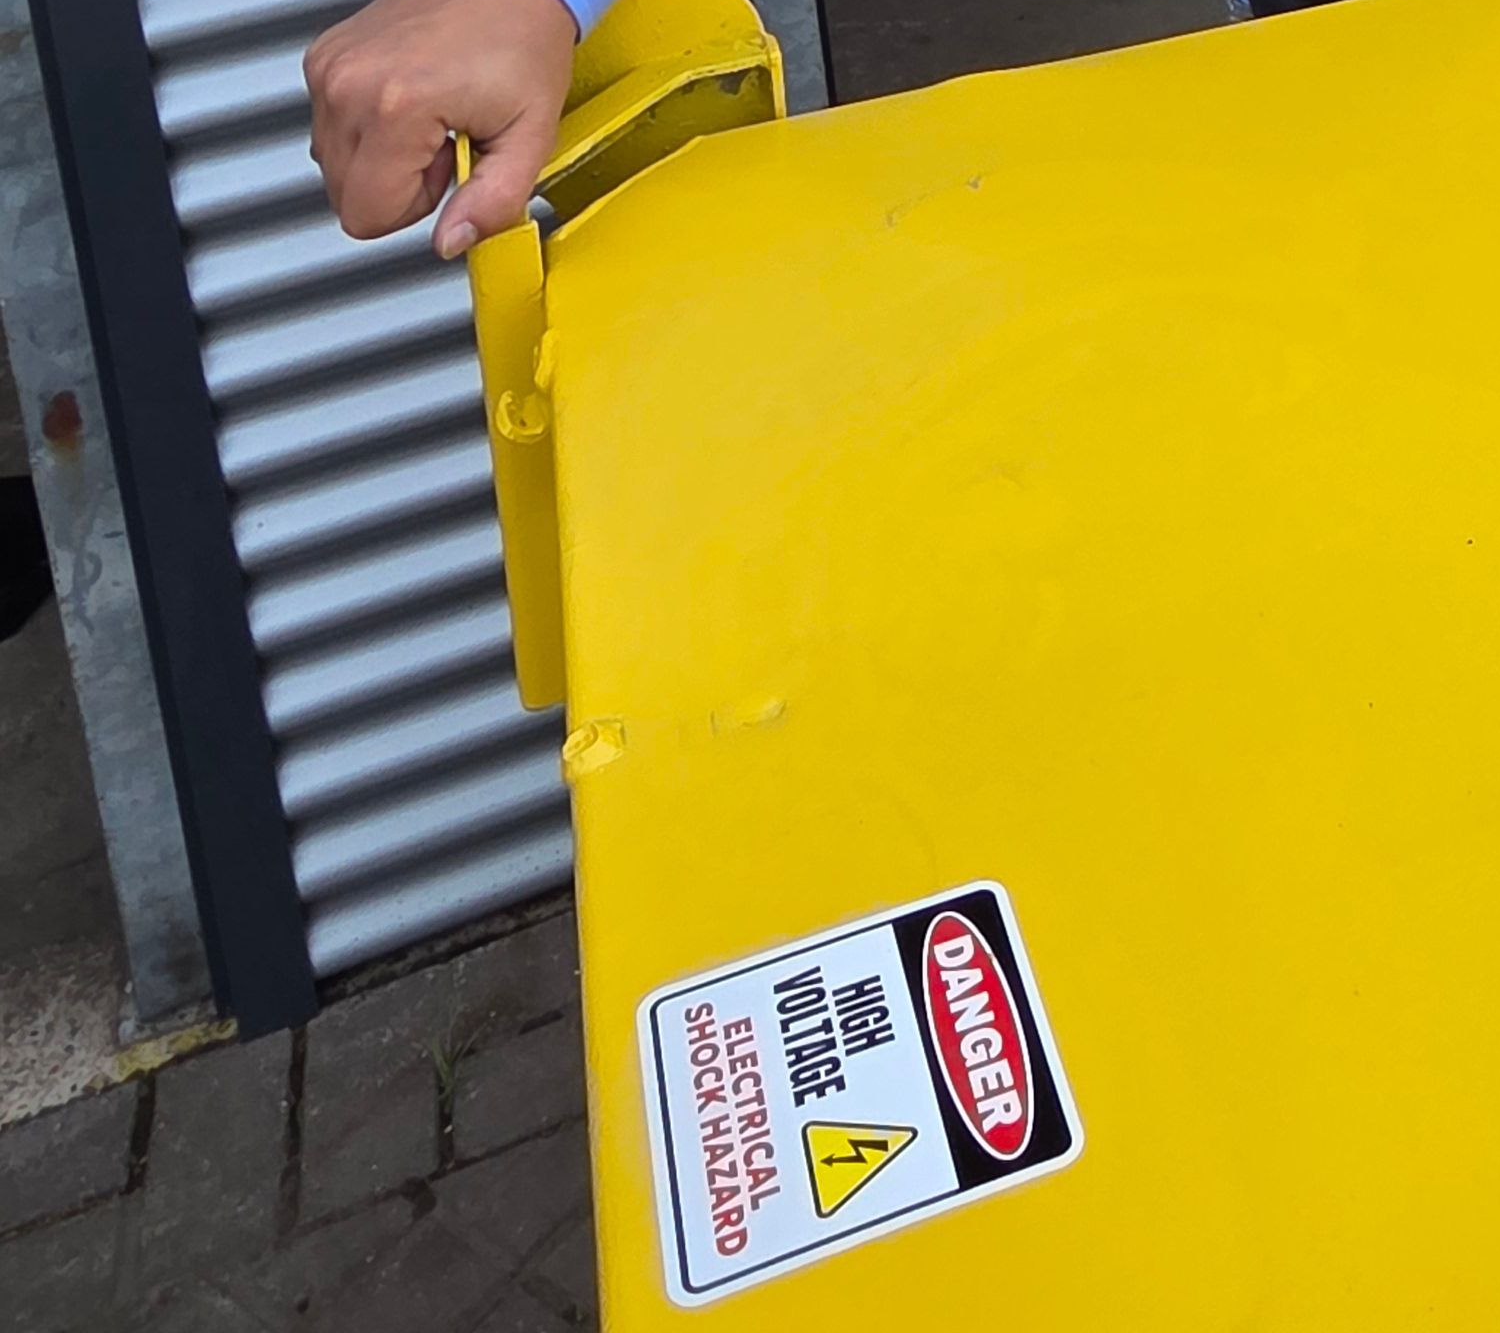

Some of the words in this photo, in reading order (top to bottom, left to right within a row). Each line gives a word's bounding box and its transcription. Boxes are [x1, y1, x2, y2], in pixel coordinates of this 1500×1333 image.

[685, 1002, 727, 1114] SHOCK
[773, 965, 846, 1108] VOLTAGE
[832, 974, 896, 1058] HIGH
[933, 934, 1024, 1135] DANGER
[700, 1110, 748, 1257] HAZARD
[722, 1016, 780, 1211] ELECTRICAL
